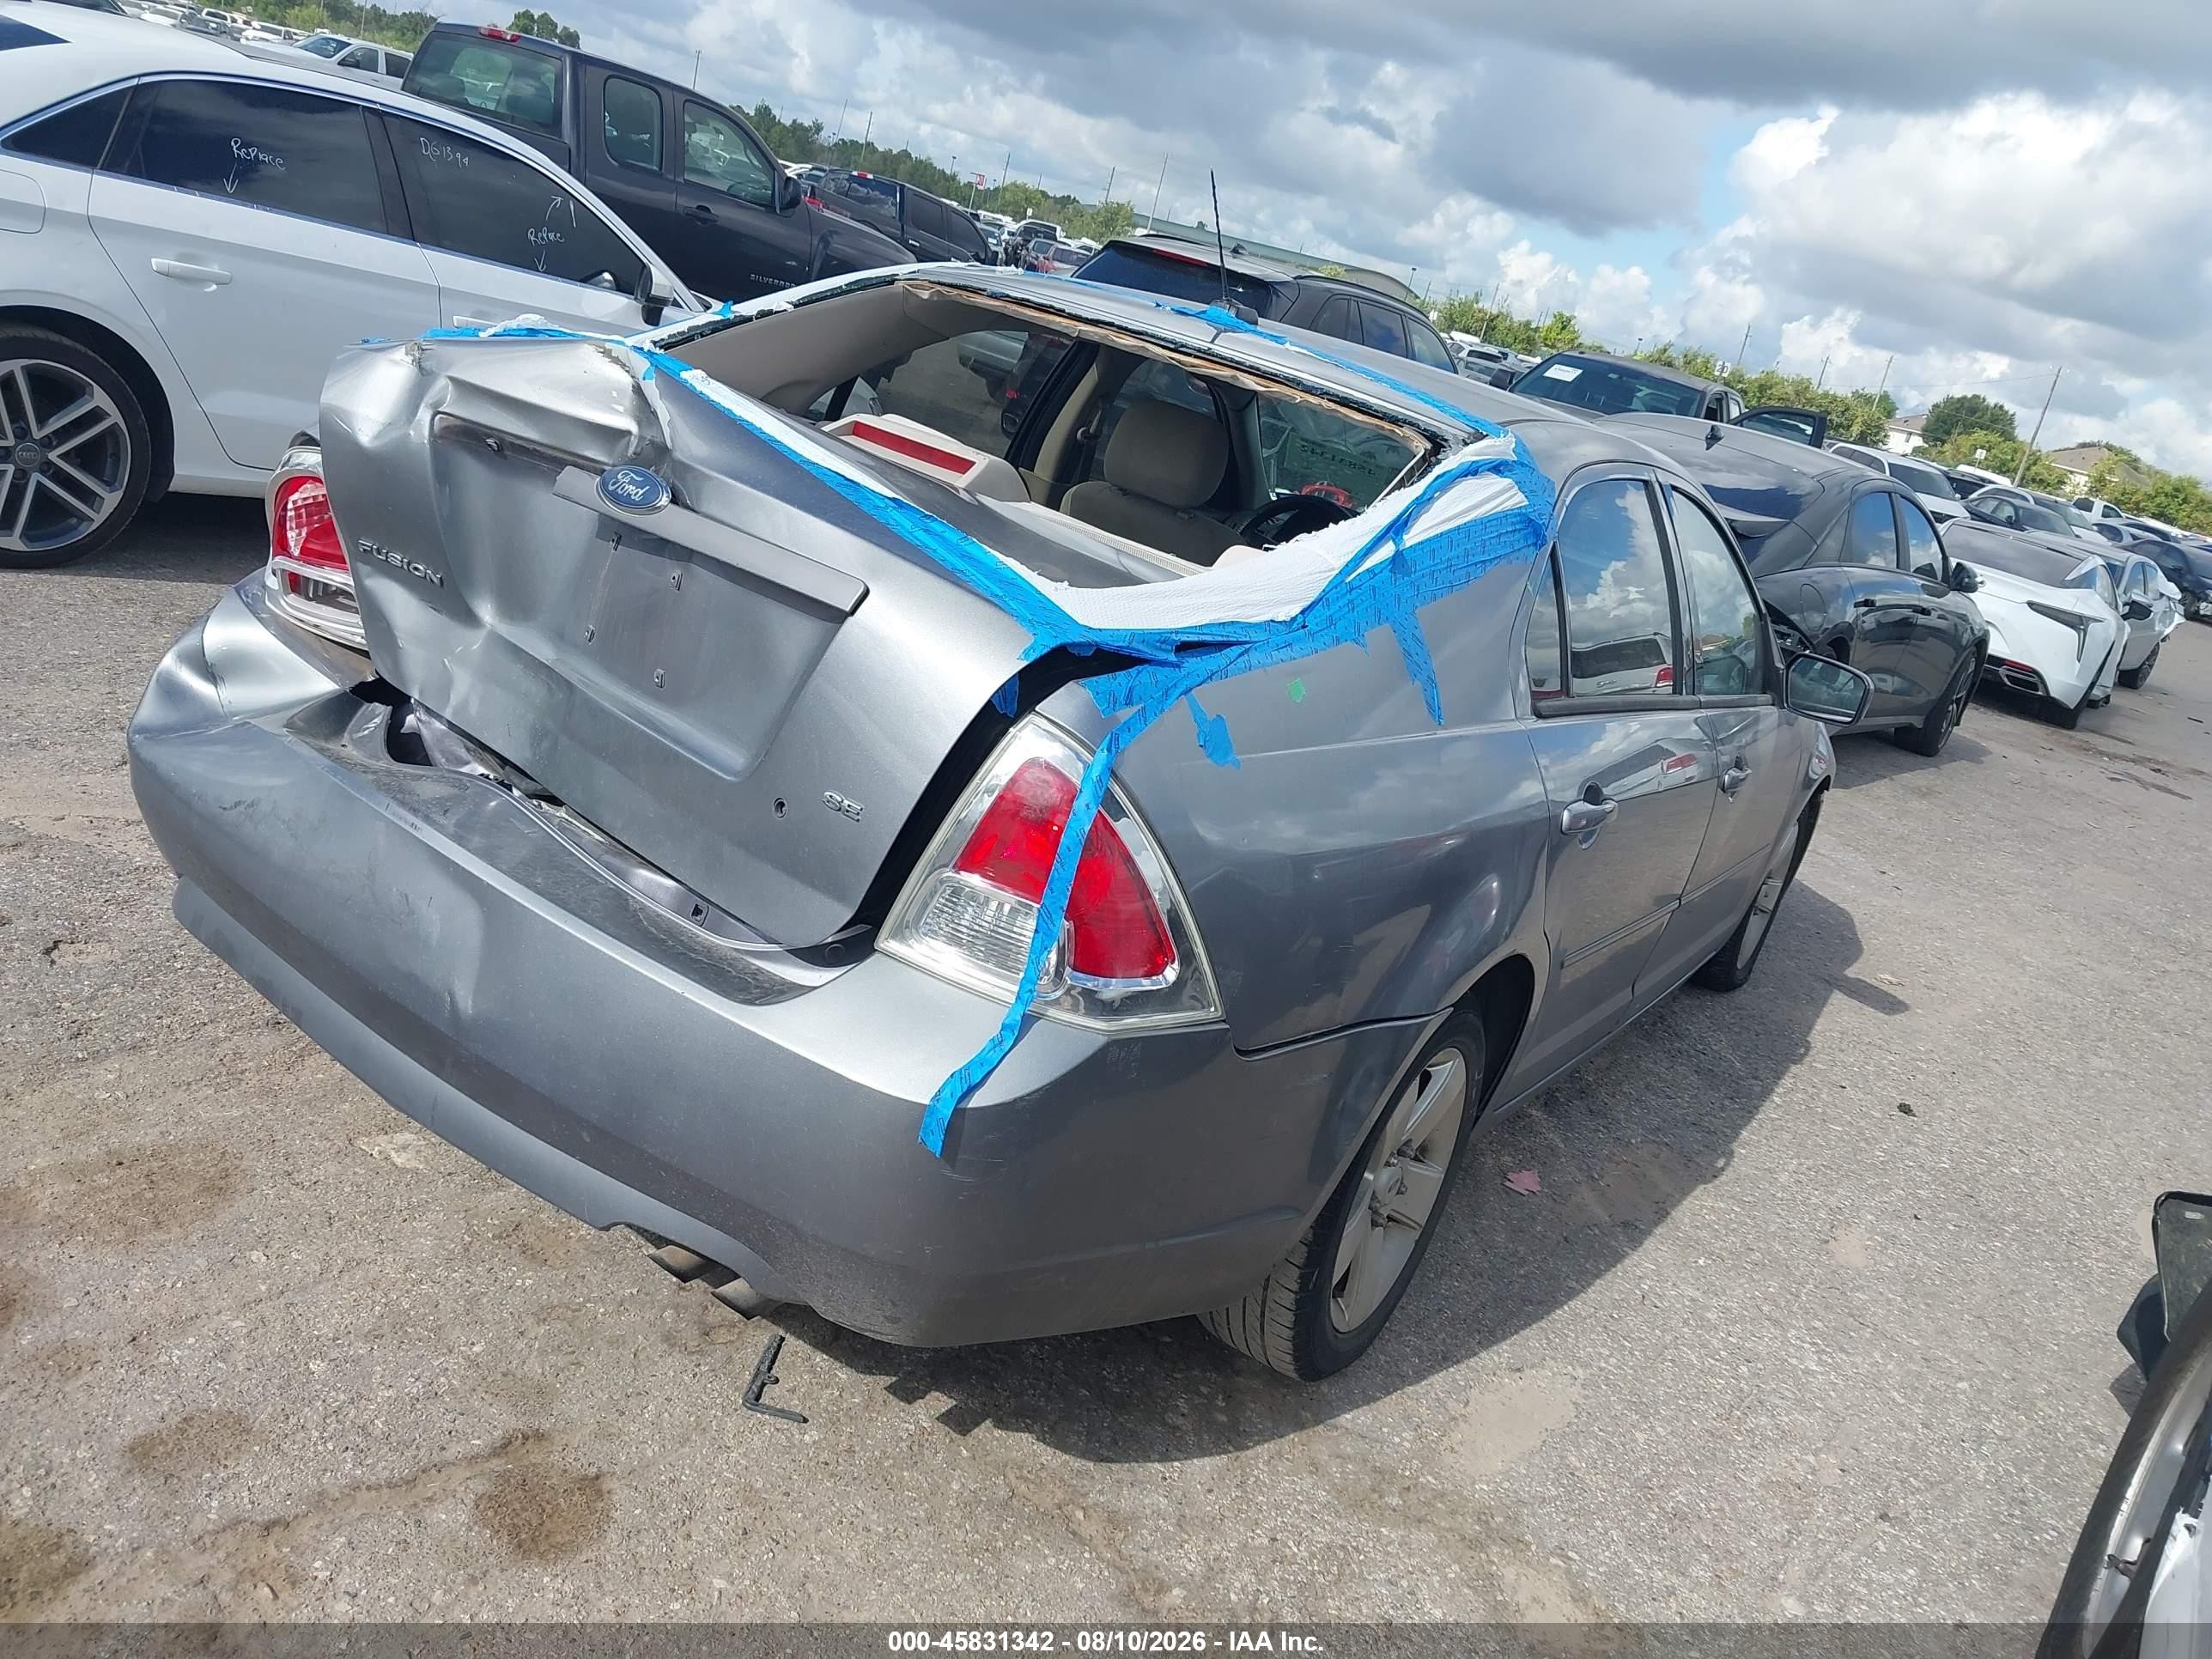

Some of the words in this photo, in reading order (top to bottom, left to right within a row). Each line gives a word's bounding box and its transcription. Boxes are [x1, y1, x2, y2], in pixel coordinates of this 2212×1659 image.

[608, 470, 651, 501] Ford
[357, 538, 445, 587] FUSION
[823, 790, 864, 823] SE
